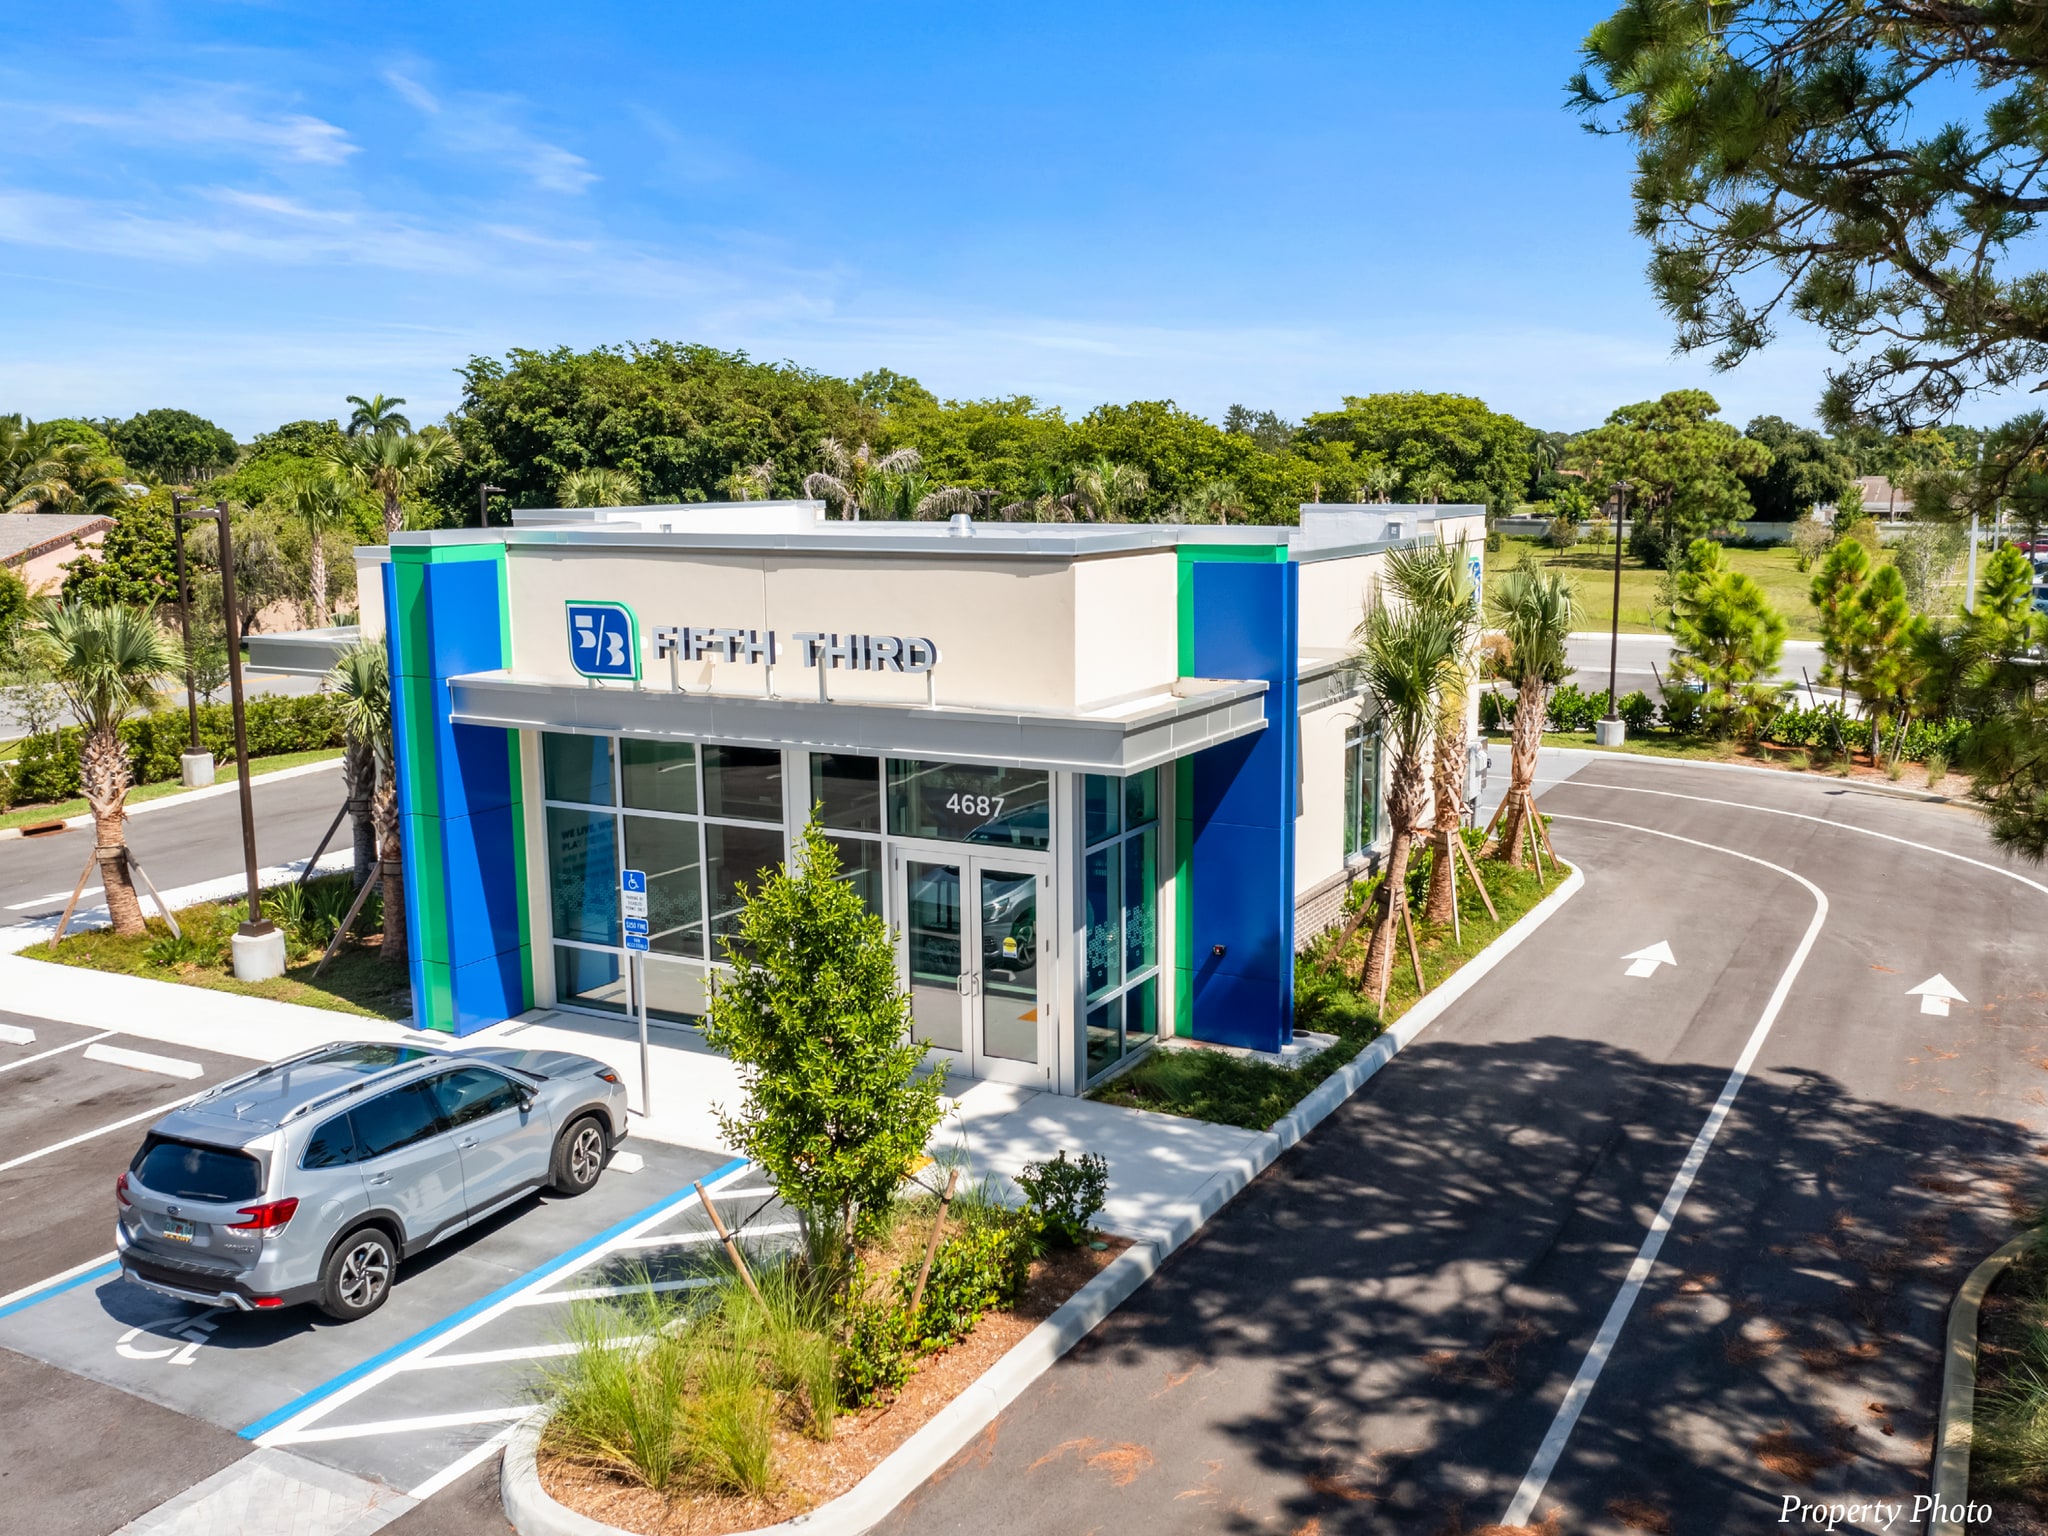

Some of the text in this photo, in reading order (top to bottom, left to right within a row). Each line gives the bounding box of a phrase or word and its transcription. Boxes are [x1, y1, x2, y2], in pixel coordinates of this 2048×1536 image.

[652, 626, 937, 674] FIFTH THIRD
[946, 793, 1005, 818] 4687
